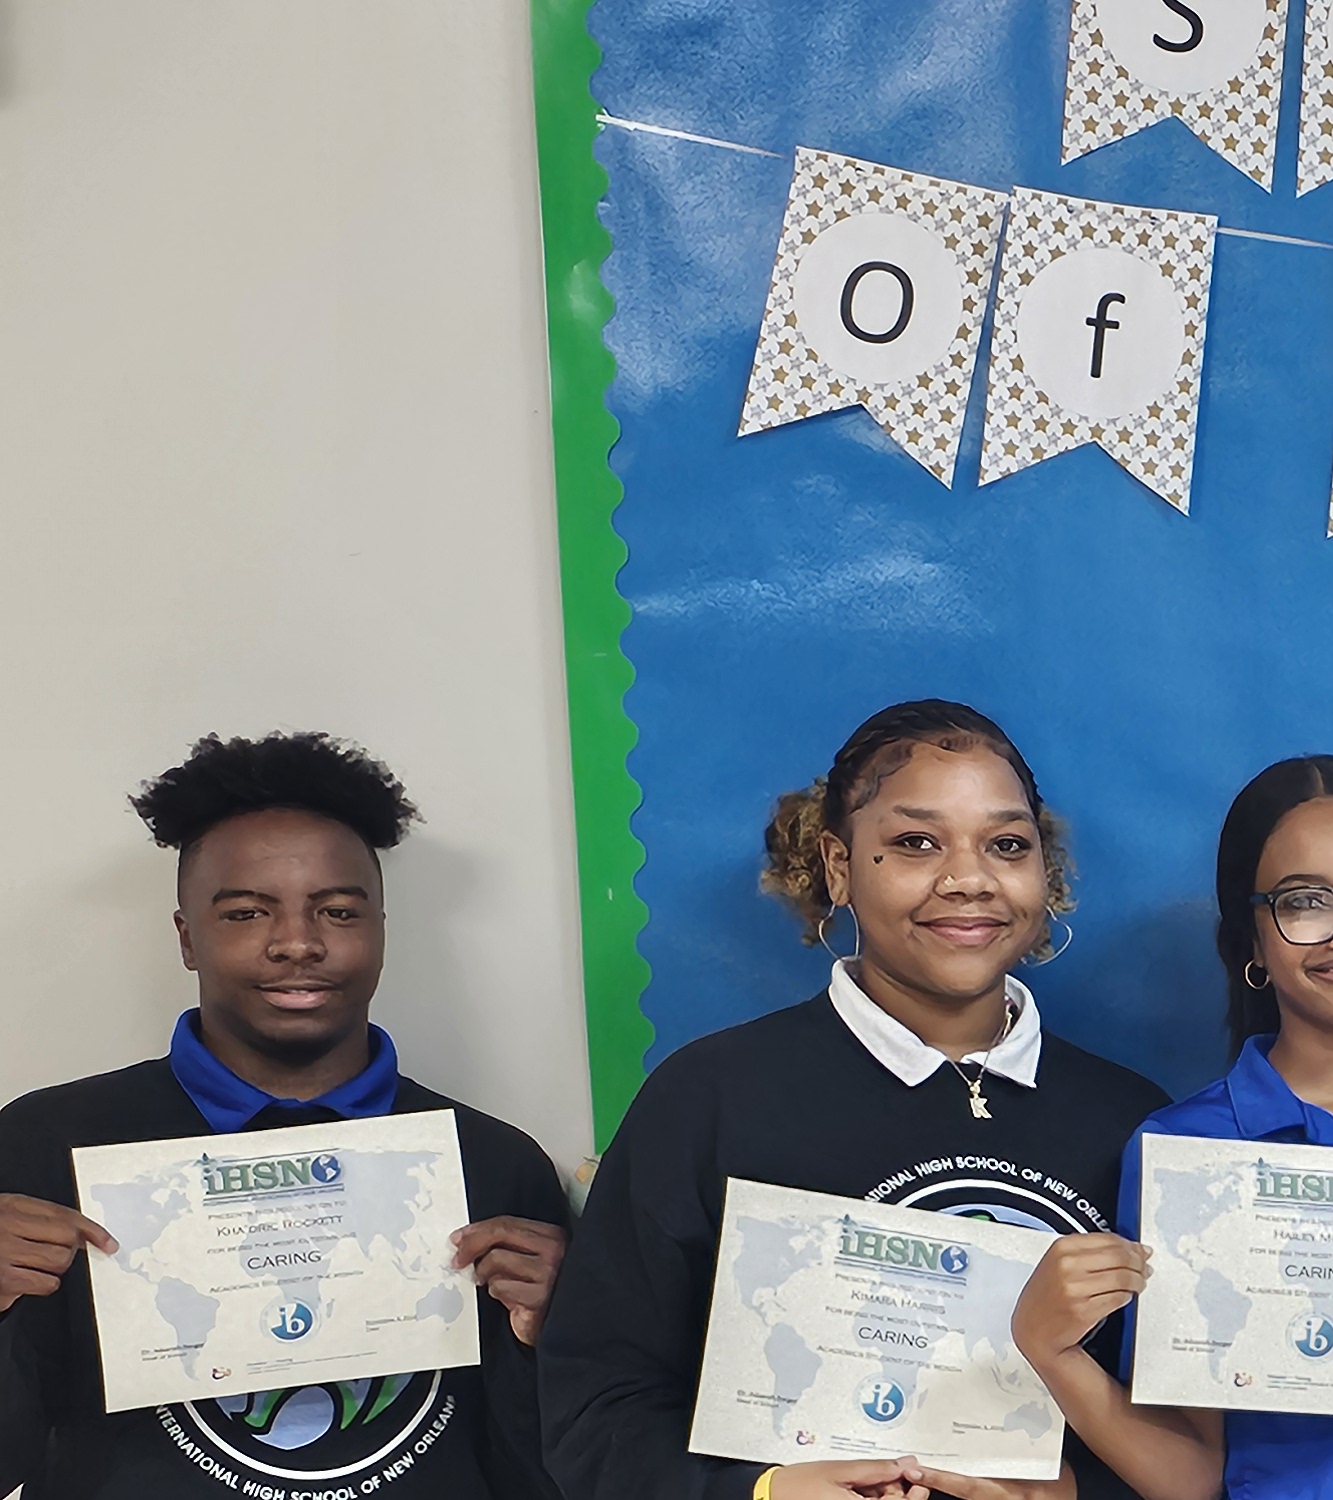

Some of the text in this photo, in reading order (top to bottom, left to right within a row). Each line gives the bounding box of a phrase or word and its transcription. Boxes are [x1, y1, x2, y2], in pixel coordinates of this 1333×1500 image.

[841, 262, 1125, 378] Of
[915, 1157, 953, 1178] HIGH
[955, 1155, 1018, 1176] SCHOOL
[1021, 1168, 1043, 1183] OF
[1044, 1177, 1079, 1201] NEW
[1076, 1199, 1110, 1234] ORLE
[248, 1251, 321, 1269] CARING
[859, 1327, 928, 1349] CARING
[156, 1405, 238, 1490] NTERNATIONAL
[360, 1476, 382, 1494] OF
[382, 1452, 415, 1482] NEW
